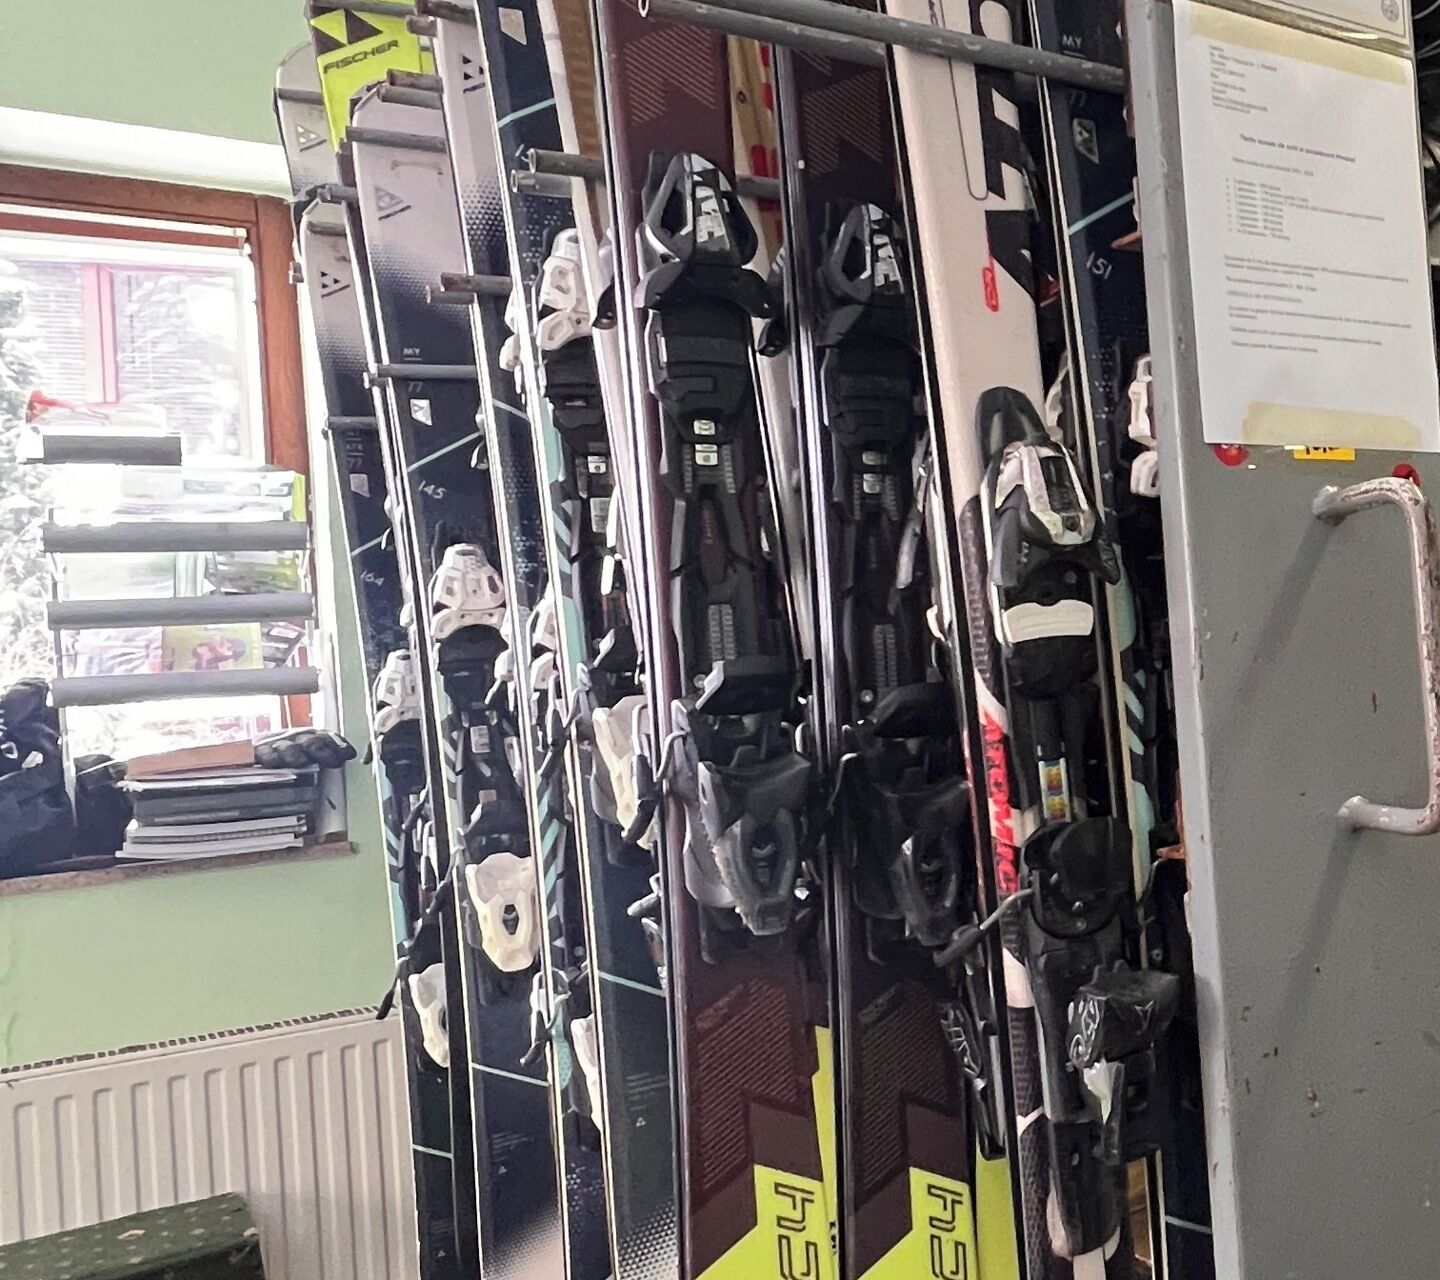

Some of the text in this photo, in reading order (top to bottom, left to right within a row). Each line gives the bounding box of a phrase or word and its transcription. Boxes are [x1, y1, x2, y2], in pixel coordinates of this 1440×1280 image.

[323, 39, 400, 74] FISCHER
[1084, 250, 1113, 280] 151
[418, 479, 448, 501] 145
[359, 568, 385, 587] 164
